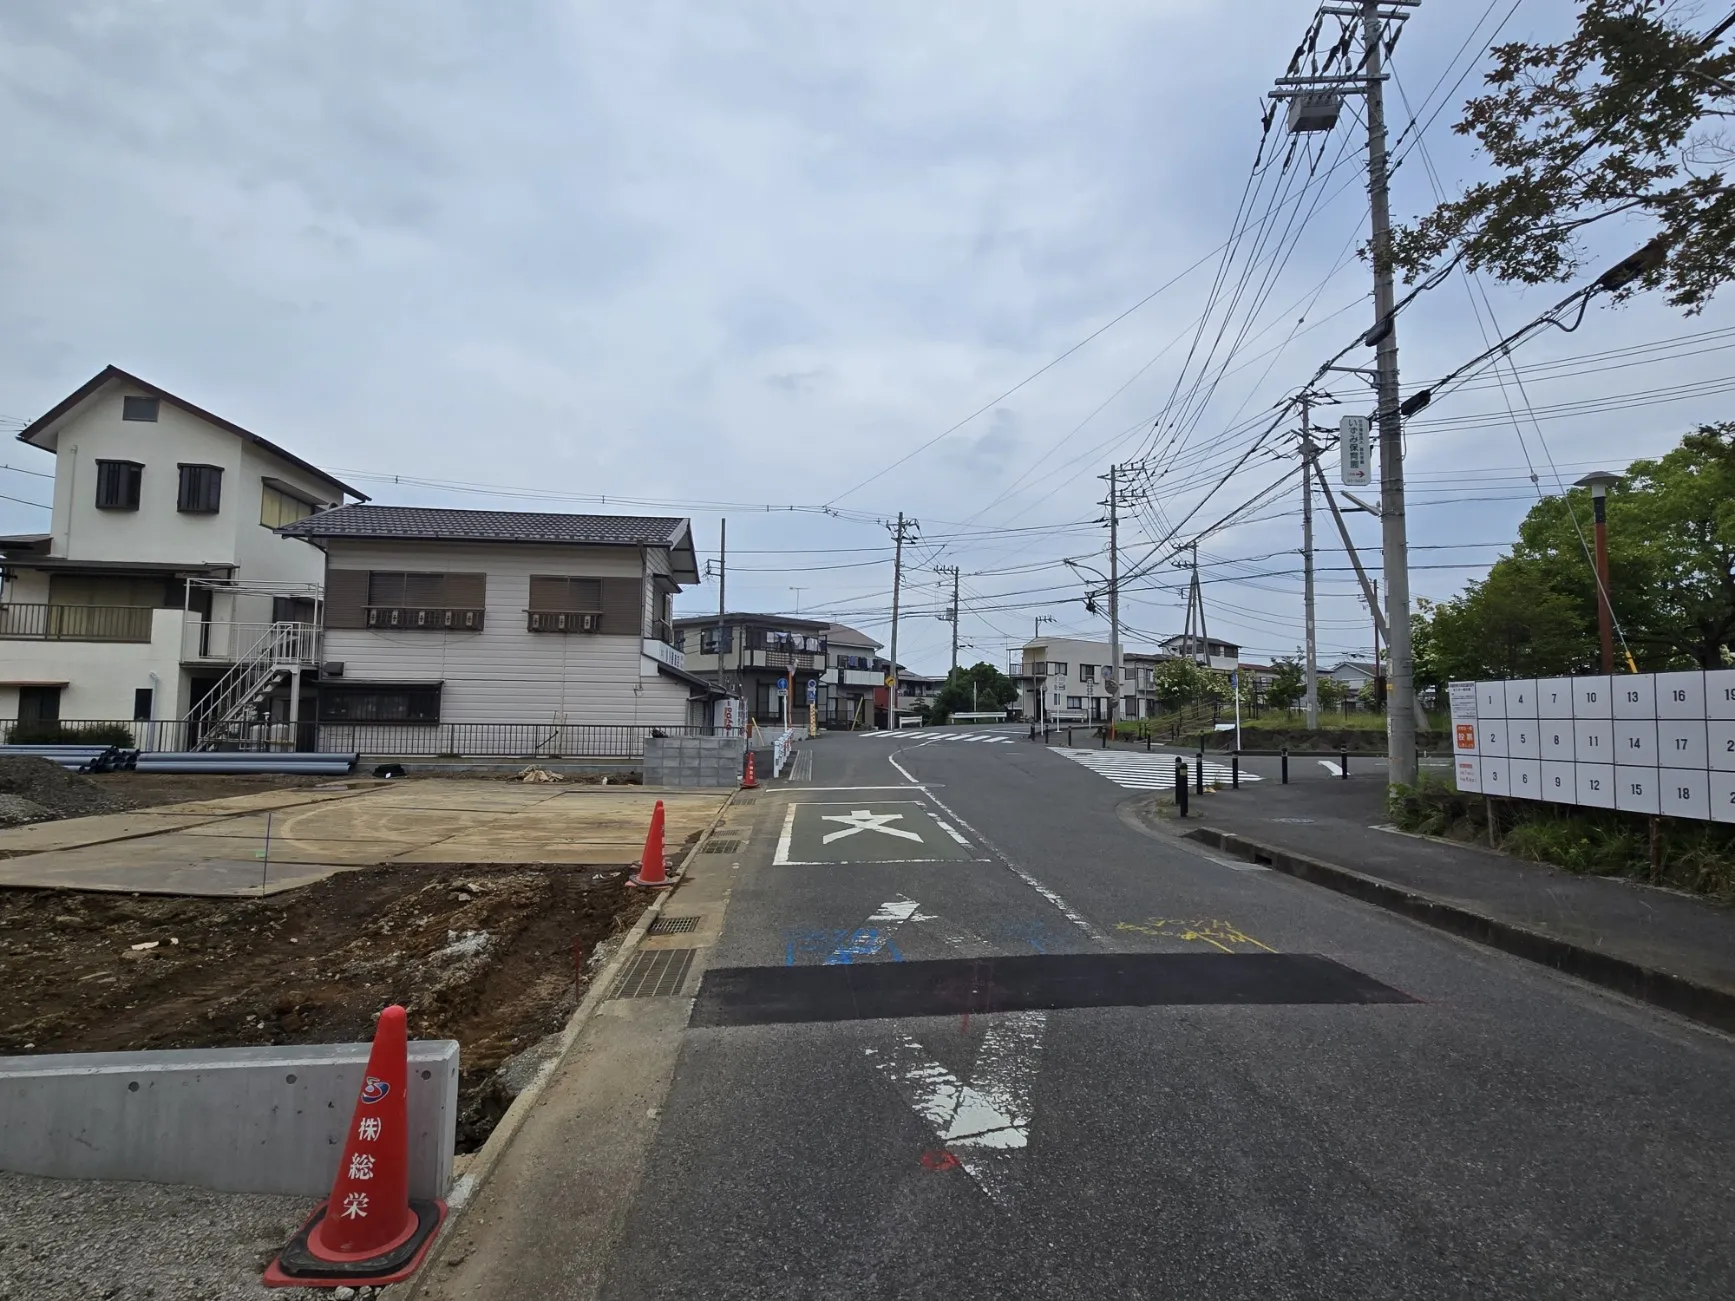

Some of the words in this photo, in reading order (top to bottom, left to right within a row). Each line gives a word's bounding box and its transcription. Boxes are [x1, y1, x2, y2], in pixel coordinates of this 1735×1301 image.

[1488, 695, 1492, 705] 1
[1518, 694, 1523, 704] 4
[1552, 693, 1557, 704] 7
[1586, 692, 1597, 703] 10
[1627, 691, 1638, 703] 13
[1673, 690, 1686, 702] 16
[1490, 733, 1495, 743] 2
[1520, 734, 1526, 744] 5
[1554, 735, 1559, 745] 8
[1588, 736, 1599, 746] 11
[1629, 738, 1641, 749] 14
[1675, 739, 1688, 750] 17
[1727, 740, 1735, 752] 2
[1492, 772, 1497, 781] 3
[1522, 774, 1528, 784] 6
[1555, 777, 1561, 787] 9
[1590, 779, 1601, 791] 12
[1630, 784, 1642, 796] 15
[1677, 787, 1690, 800] 18
